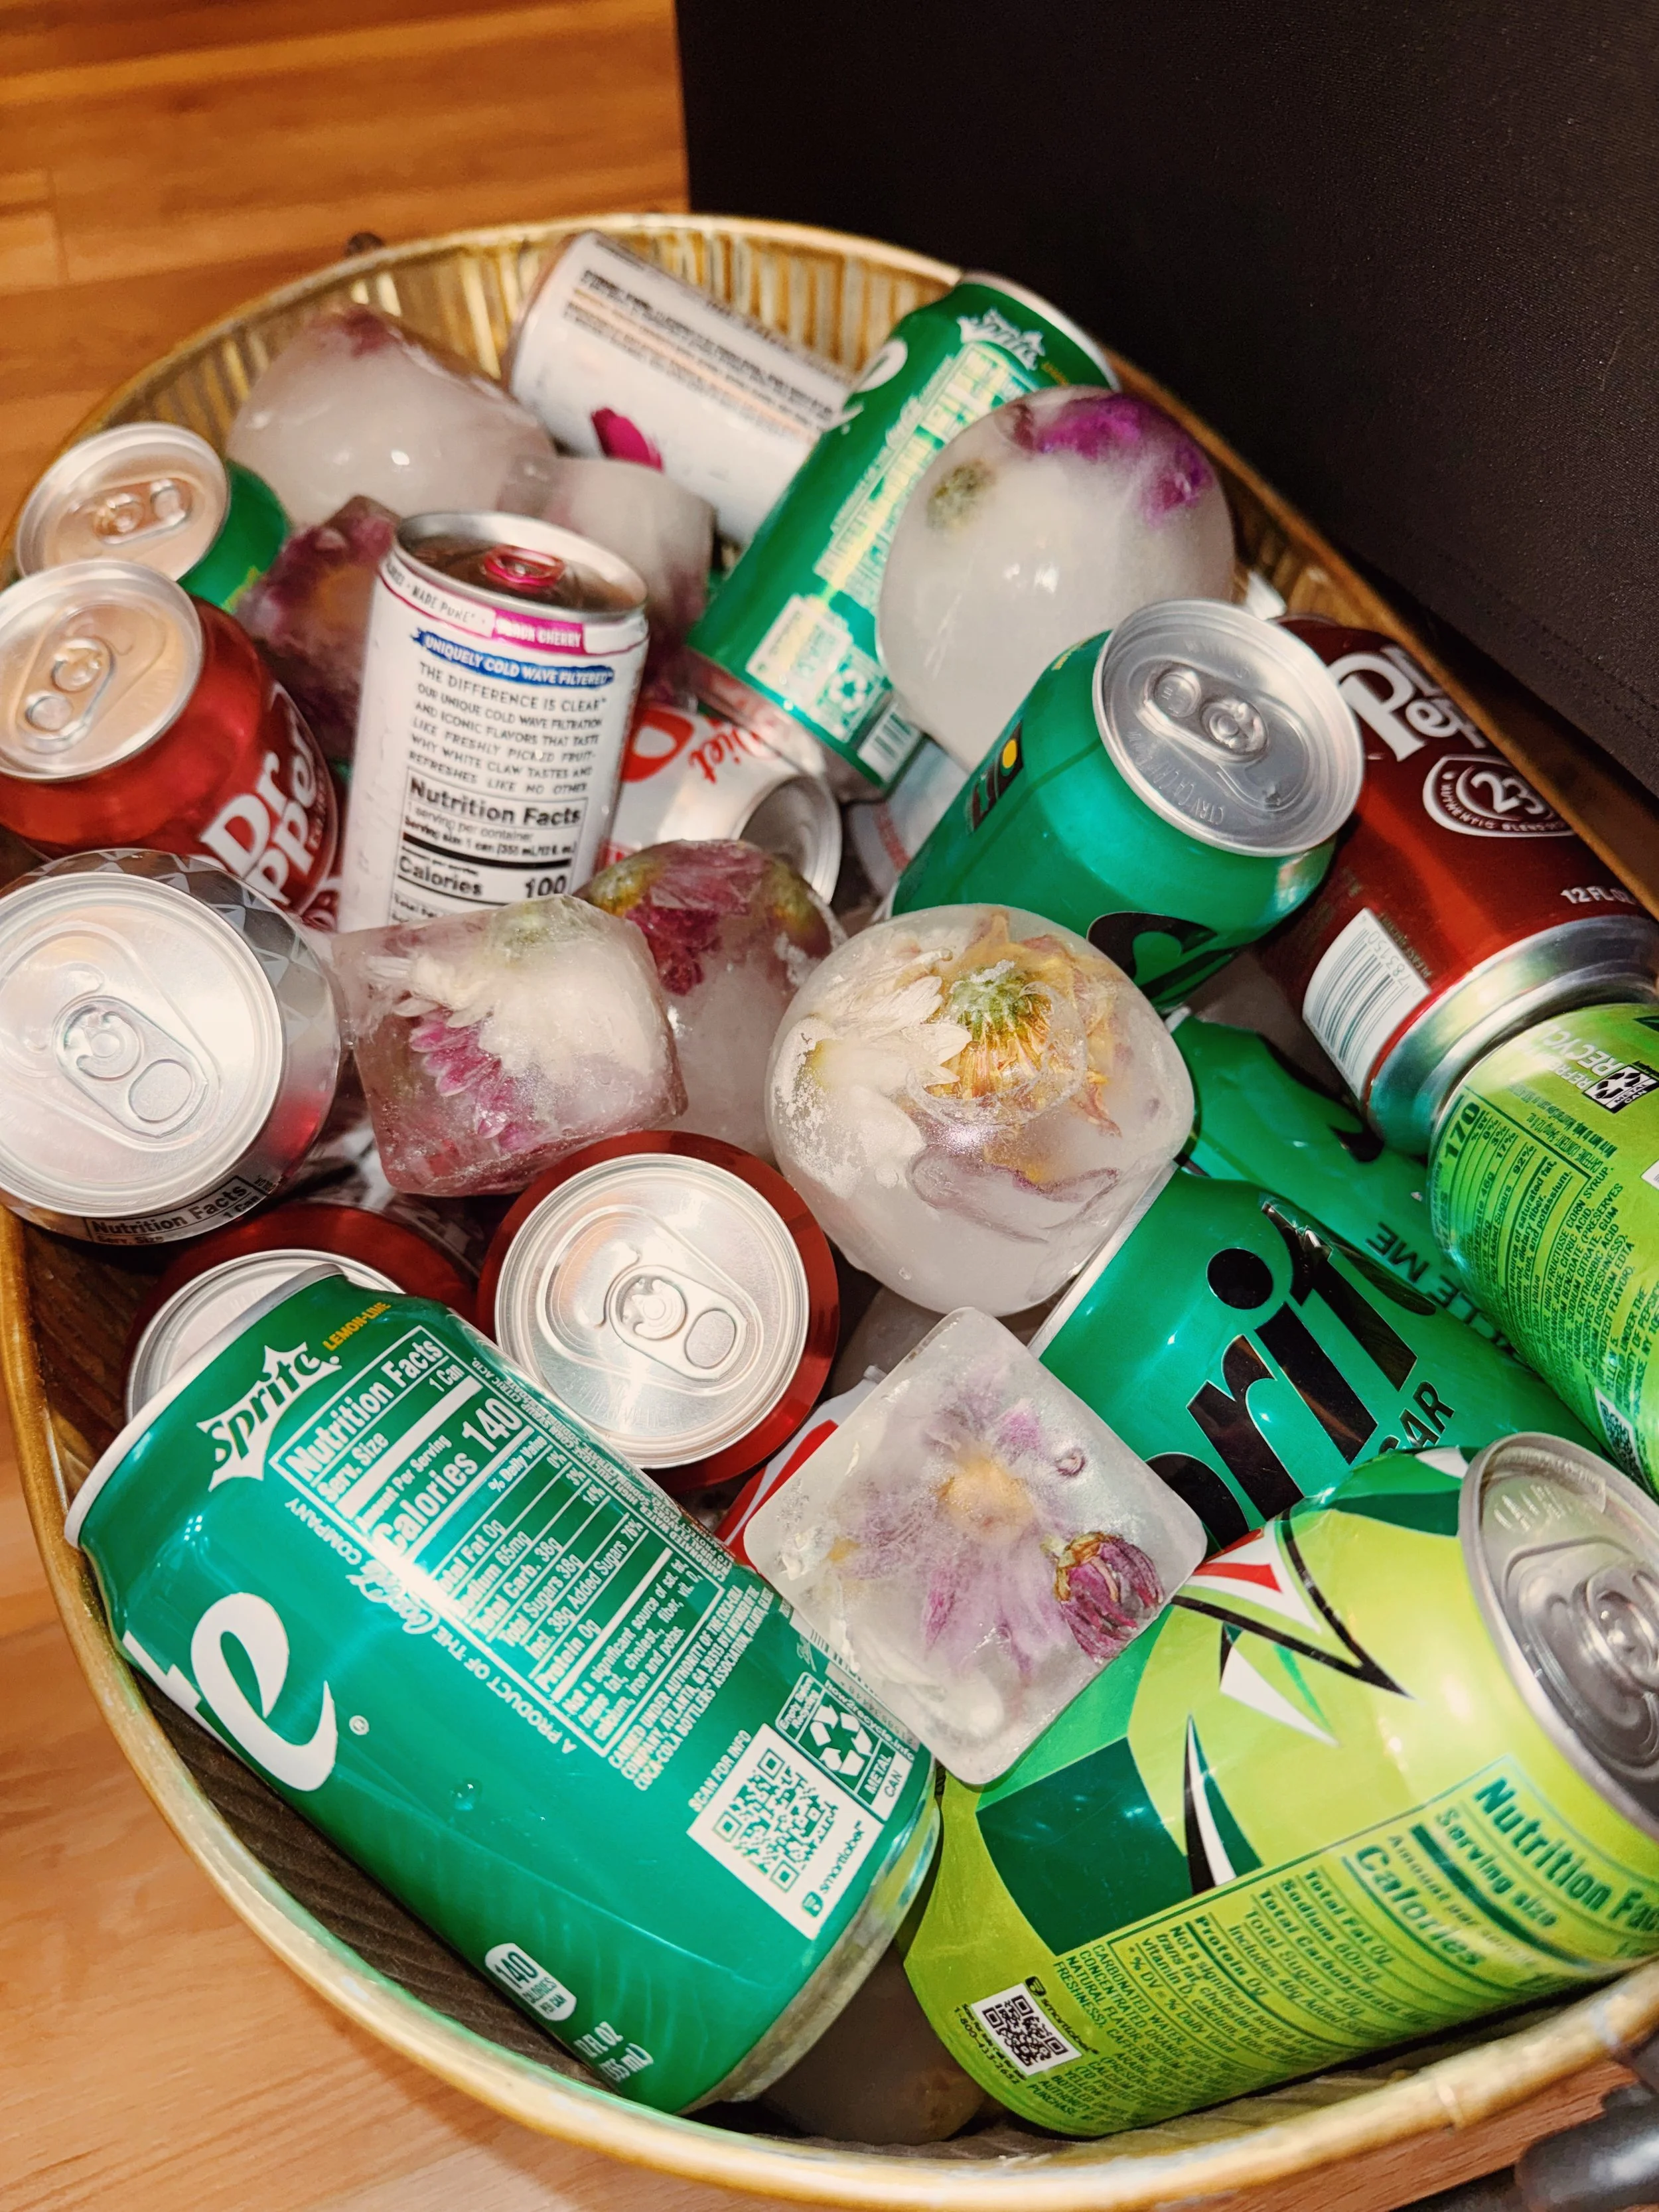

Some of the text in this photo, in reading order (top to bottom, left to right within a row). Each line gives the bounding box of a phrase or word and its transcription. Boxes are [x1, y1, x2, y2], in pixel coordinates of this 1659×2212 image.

[423, 632, 484, 670] UNIQUELY
[482, 655, 522, 679] COLD
[520, 663, 559, 684] WAVE
[536, 628, 583, 648] CHERRY
[417, 660, 445, 684] THE
[445, 673, 540, 711] DIFFERENCE
[542, 697, 557, 710] IS
[439, 690, 482, 716] UNIQUE
[484, 705, 517, 724] COLD
[517, 713, 549, 728] WAVE
[411, 717, 501, 757] LIKE FRESHLY
[414, 700, 439, 718] AND
[439, 711, 483, 734] ICONIC
[484, 725, 540, 745] FLAVORS
[440, 745, 482, 769] WHITE
[485, 759, 523, 776] CLAW
[407, 776, 582, 826] Nutrition Facts
[396, 854, 484, 896] Calories
[522, 873, 568, 897] 100
[1623, 1088, 1648, 1105] CAN
[1441, 1099, 1482, 1163] 170
[1511, 1142, 1535, 1175] 92%
[90, 1209, 189, 1235] Nutrition
[187, 1181, 248, 1222] Facts
[1515, 1175, 1546, 1230] saturated
[1597, 1205, 1620, 1232] GUM
[1362, 1219, 1433, 1285] ME
[1545, 1198, 1587, 1284] FRUCTOSE CORN
[1559, 1242, 1587, 1300] BENZOATE
[1577, 1221, 1621, 1319] ERYTHORBIC ACID
[321, 1296, 392, 1353] LEMON-LIME
[201, 1346, 330, 1471] Sprite
[283, 1331, 445, 1485] Nutrition Facts
[315, 1360, 466, 1506] Serv. Size Can
[374, 1390, 524, 1558] Calories 140
[390, 1465, 417, 1493] Per
[408, 1430, 453, 1475] Serving
[498, 1433, 549, 1484] Daily Value
[283, 1492, 366, 1568] COMPANY
[494, 1528, 534, 1568] 65mg
[565, 1464, 587, 1488] 3%
[500, 1555, 543, 1601] Carb.
[533, 1534, 564, 1564] 38g
[582, 1482, 607, 1509] 14%
[433, 1515, 507, 1595] otal Fat 0g
[497, 1551, 585, 1649] Total Sugars 38g
[522, 1515, 644, 1662] Incl. 38g Added Sugars 76%
[431, 1623, 470, 1661] THE
[463, 1651, 494, 1682] OF
[533, 1616, 604, 1694] Protein 0g
[561, 1582, 669, 1718] Not significant source of
[624, 1666, 653, 1698] iron
[641, 1647, 668, 1676] and
[689, 1641, 727, 1687] GA 30313
[485, 1672, 566, 1745] PRODUCT
[577, 1690, 611, 1729] trans
[606, 1722, 648, 1771] CANNED
[636, 1689, 673, 1730] UNDER
[661, 1639, 709, 1697] AUTHORITY
[696, 1629, 715, 1647] OF
[631, 1730, 684, 1793] COCA-COLA
[686, 1726, 753, 1814] SCAN FOR INFO
[862, 1749, 895, 1797] METAL
[880, 1767, 906, 1800] CAN
[1386, 1830, 1453, 1903] Amount
[1433, 1803, 1517, 1898] Serving
[1471, 1770, 1619, 1915] Nutrition
[1257, 1887, 1302, 1937] Total
[1277, 1875, 1339, 1945] Sodium
[1302, 1868, 1374, 1947] Total Fat
[1350, 1836, 1488, 1974] Calories
[492, 1945, 541, 1994] 140
[1140, 1936, 1186, 1986] vitamin
[1154, 1929, 1188, 1968] trans
[1168, 1922, 1258, 2020] Not significant
[1194, 1914, 1250, 1979] Protein
[1227, 1923, 1279, 1981] Includes
[1242, 1906, 1334, 2002] Total Sugars
[1065, 1953, 1108, 2004] NATURAL
[1078, 1949, 1147, 2031] CONCENTRATED
[1090, 1942, 1151, 2016] CARBONATED
[1139, 1968, 1207, 2037] DV Daily
